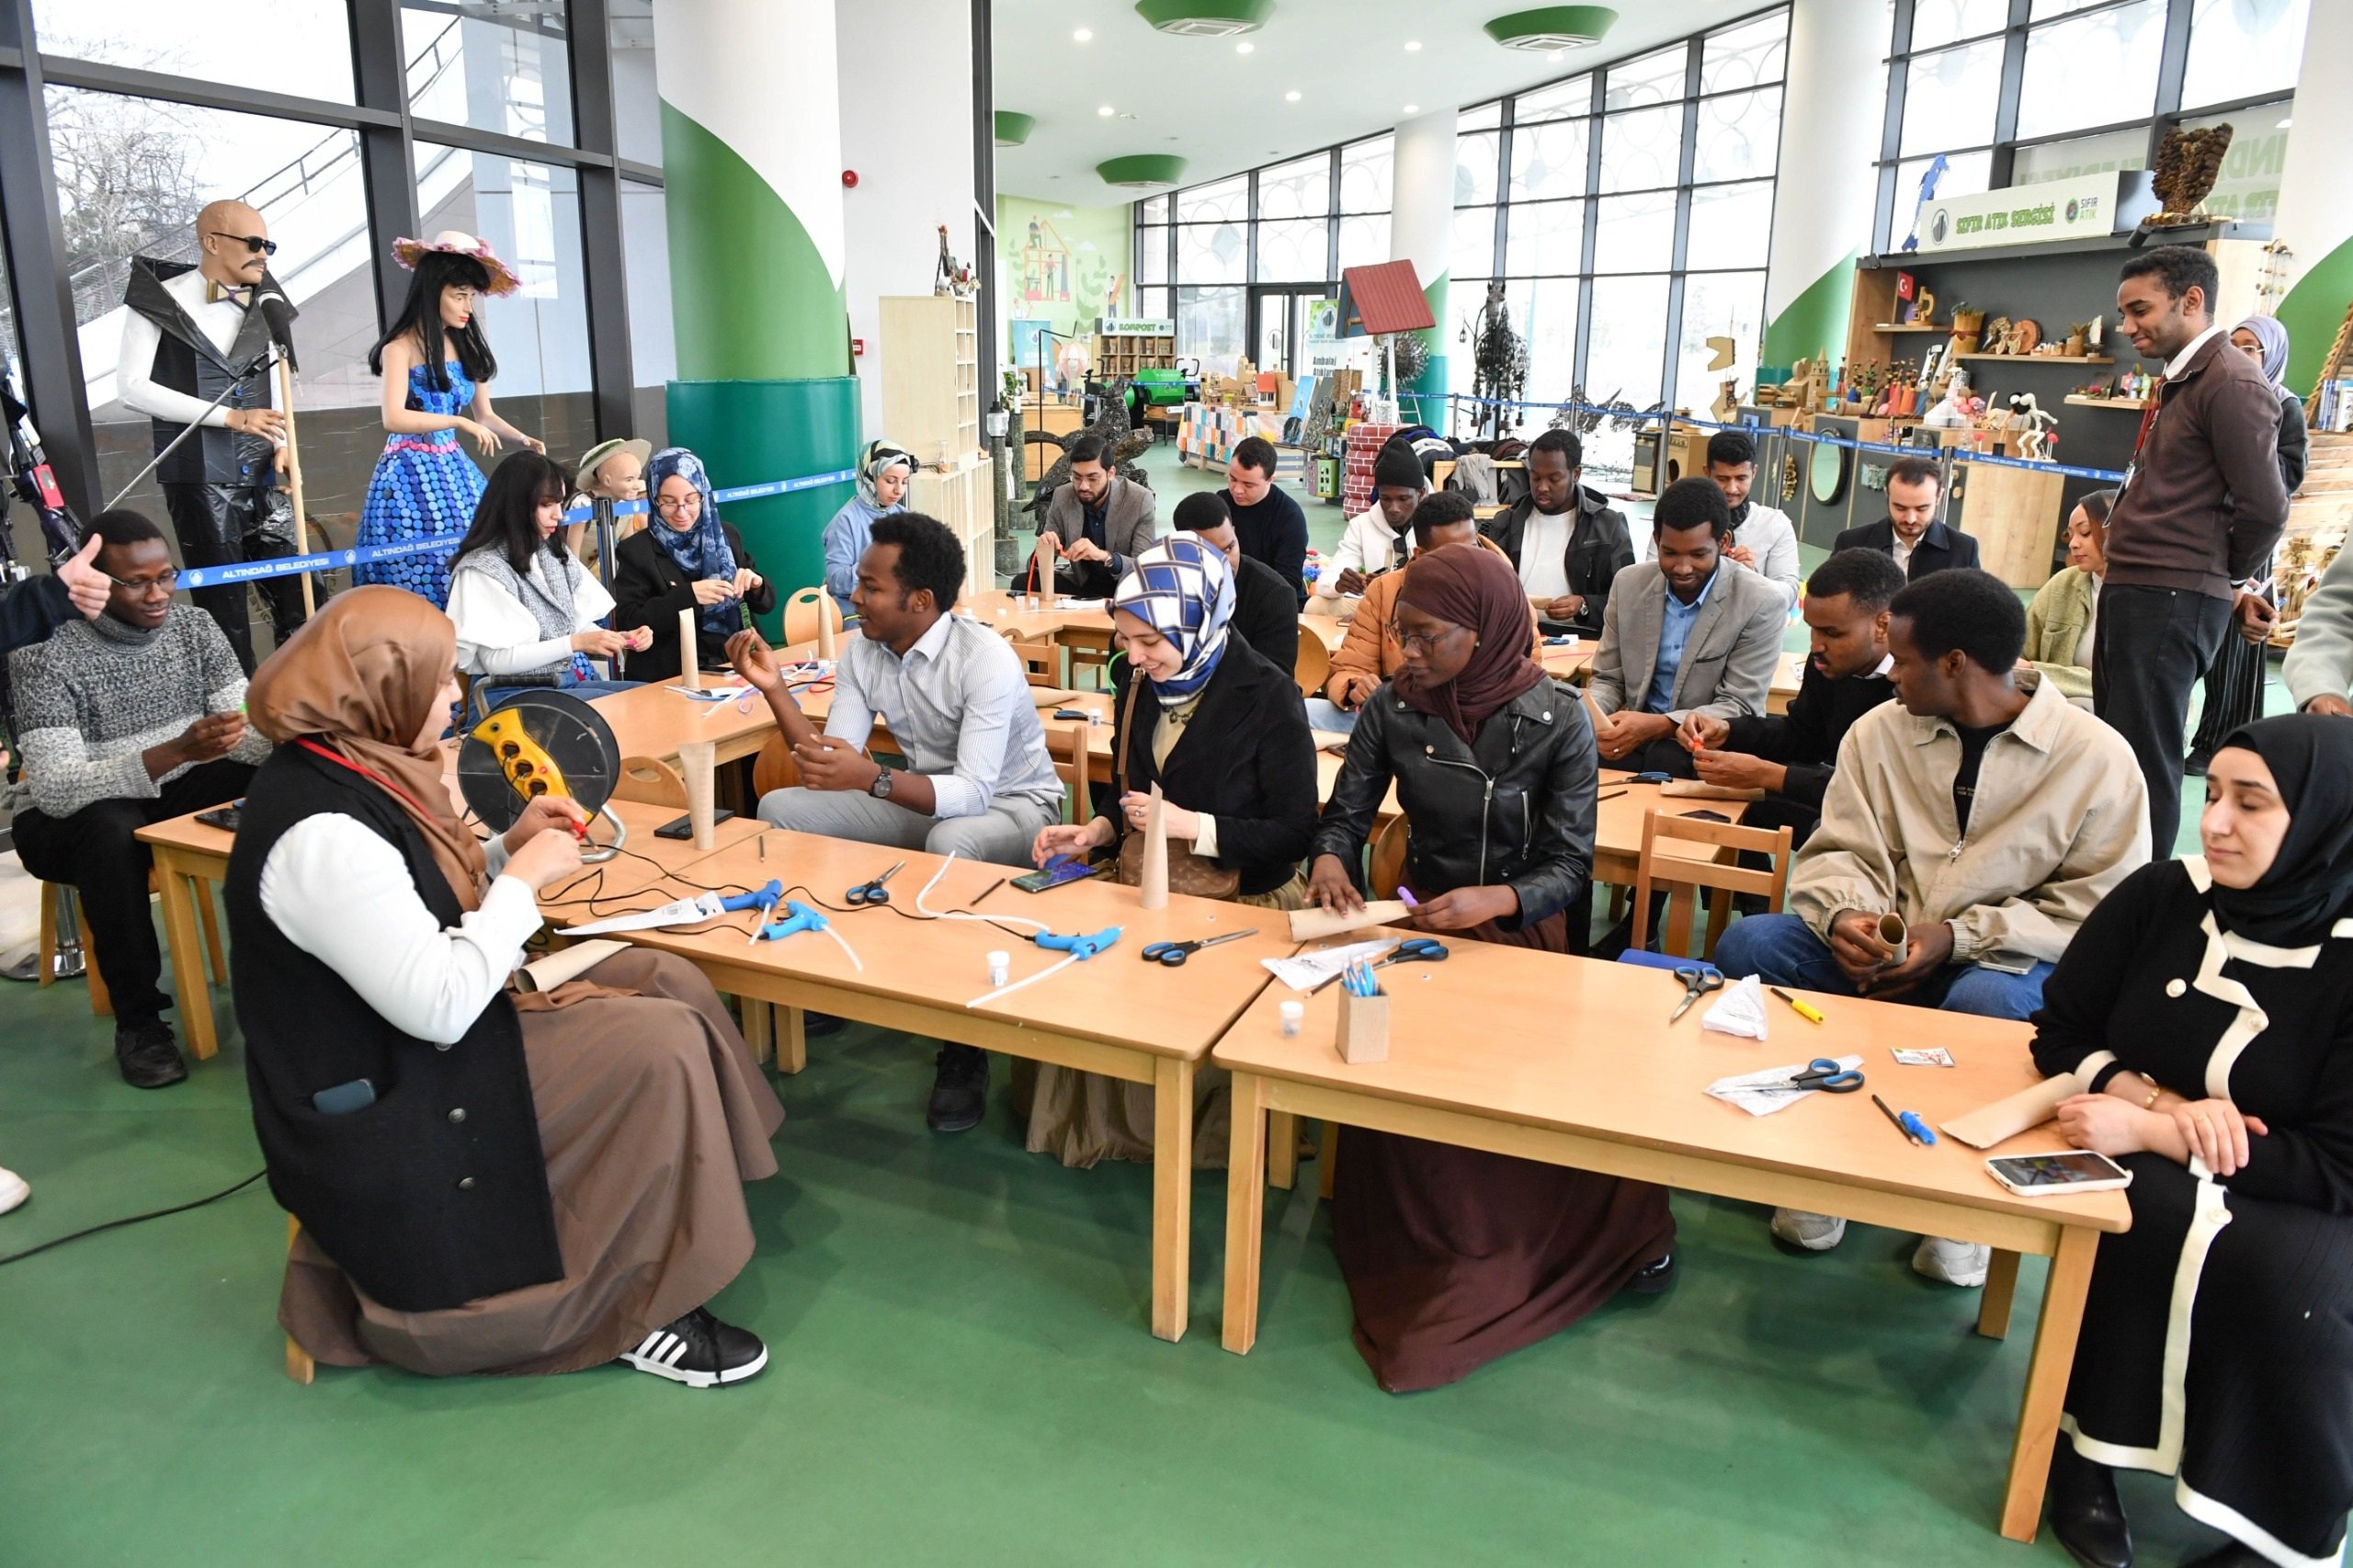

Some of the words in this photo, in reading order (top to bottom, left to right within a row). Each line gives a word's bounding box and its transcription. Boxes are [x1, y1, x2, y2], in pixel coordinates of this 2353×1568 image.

[2081, 197, 2098, 209] SIFIR
[1956, 215, 1983, 234] SIFIR
[1984, 211, 2008, 230] ATIK
[1119, 323, 1156, 332] KOMPOST
[371, 543, 414, 557] ALTINDAĞ
[222, 564, 273, 578] ALTINDAĞ
